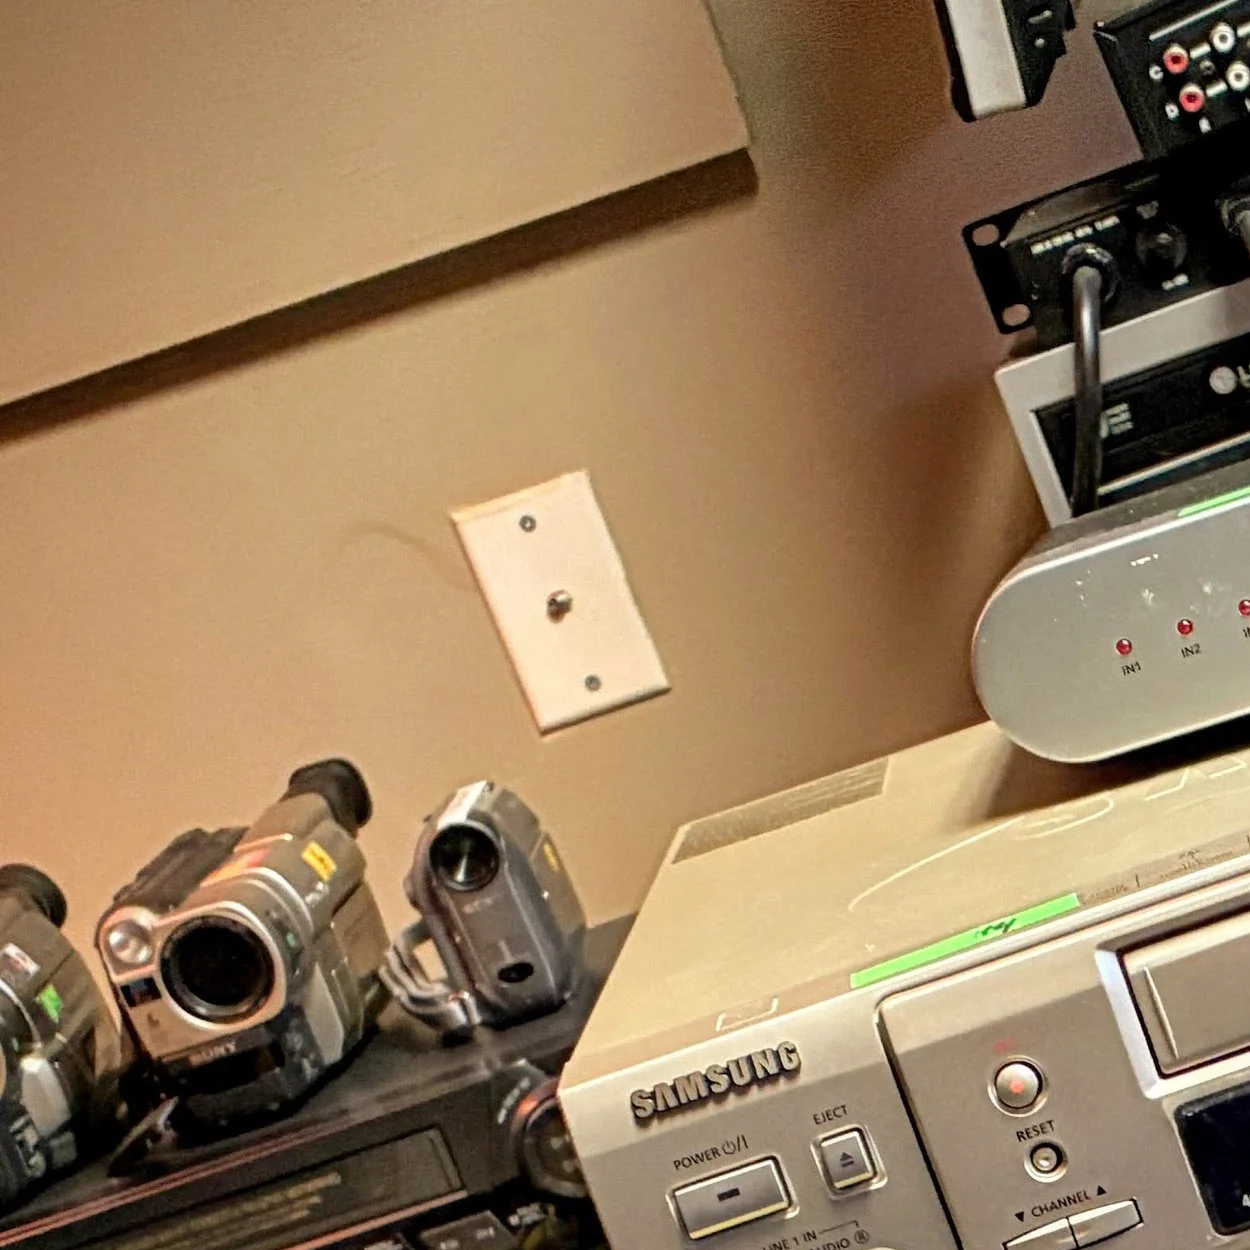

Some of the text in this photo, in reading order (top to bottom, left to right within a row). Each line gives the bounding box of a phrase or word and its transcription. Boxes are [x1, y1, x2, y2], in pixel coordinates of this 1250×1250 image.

[1180, 643, 1201, 658] IN2
[1121, 660, 1142, 676] IN1
[630, 1040, 802, 1120] SAMSUNG
[812, 1104, 848, 1125] EJECT
[1016, 1120, 1056, 1144] RESET
[673, 1147, 720, 1171] POWER
[1031, 1188, 1092, 1219] CHANNEL
[802, 1229, 817, 1243] IN
